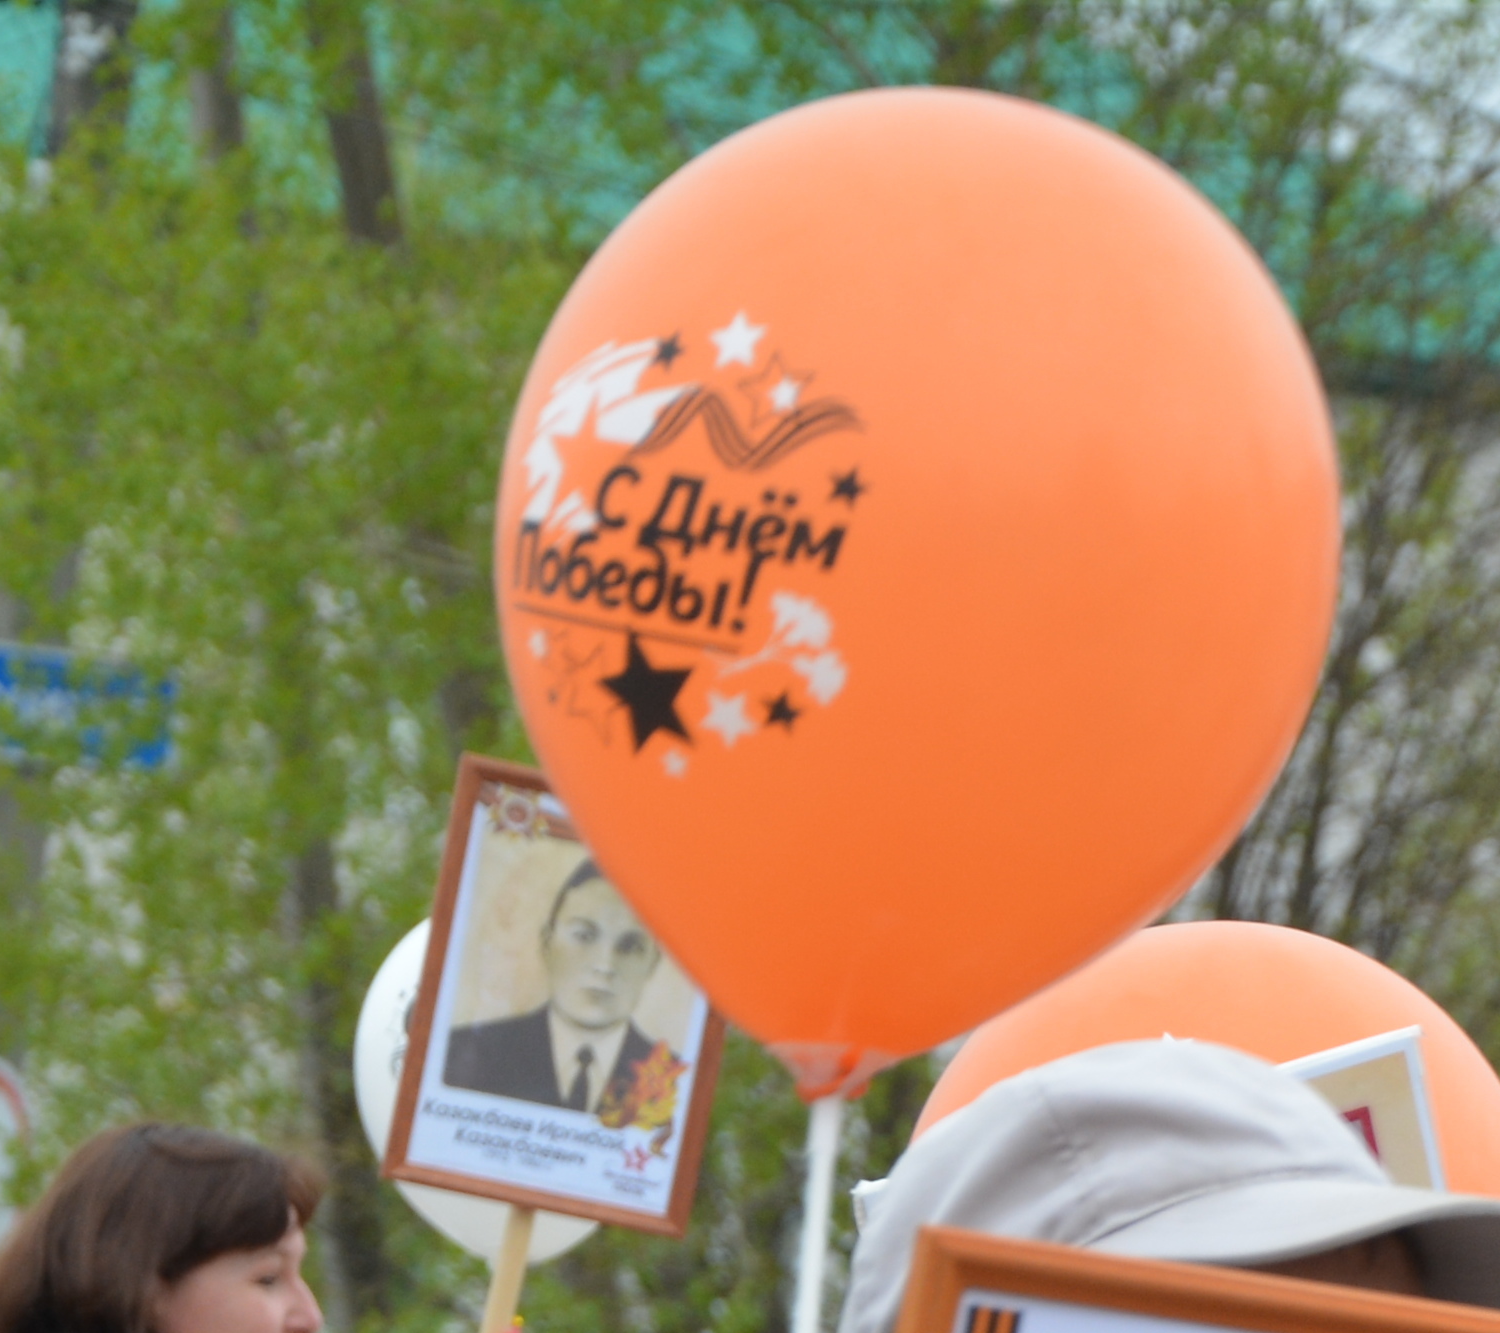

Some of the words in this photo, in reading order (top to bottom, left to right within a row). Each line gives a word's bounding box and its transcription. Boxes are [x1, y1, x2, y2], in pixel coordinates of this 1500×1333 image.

[594, 465, 642, 530] С
[638, 472, 848, 572] Днём
[511, 522, 753, 634] Победы!
